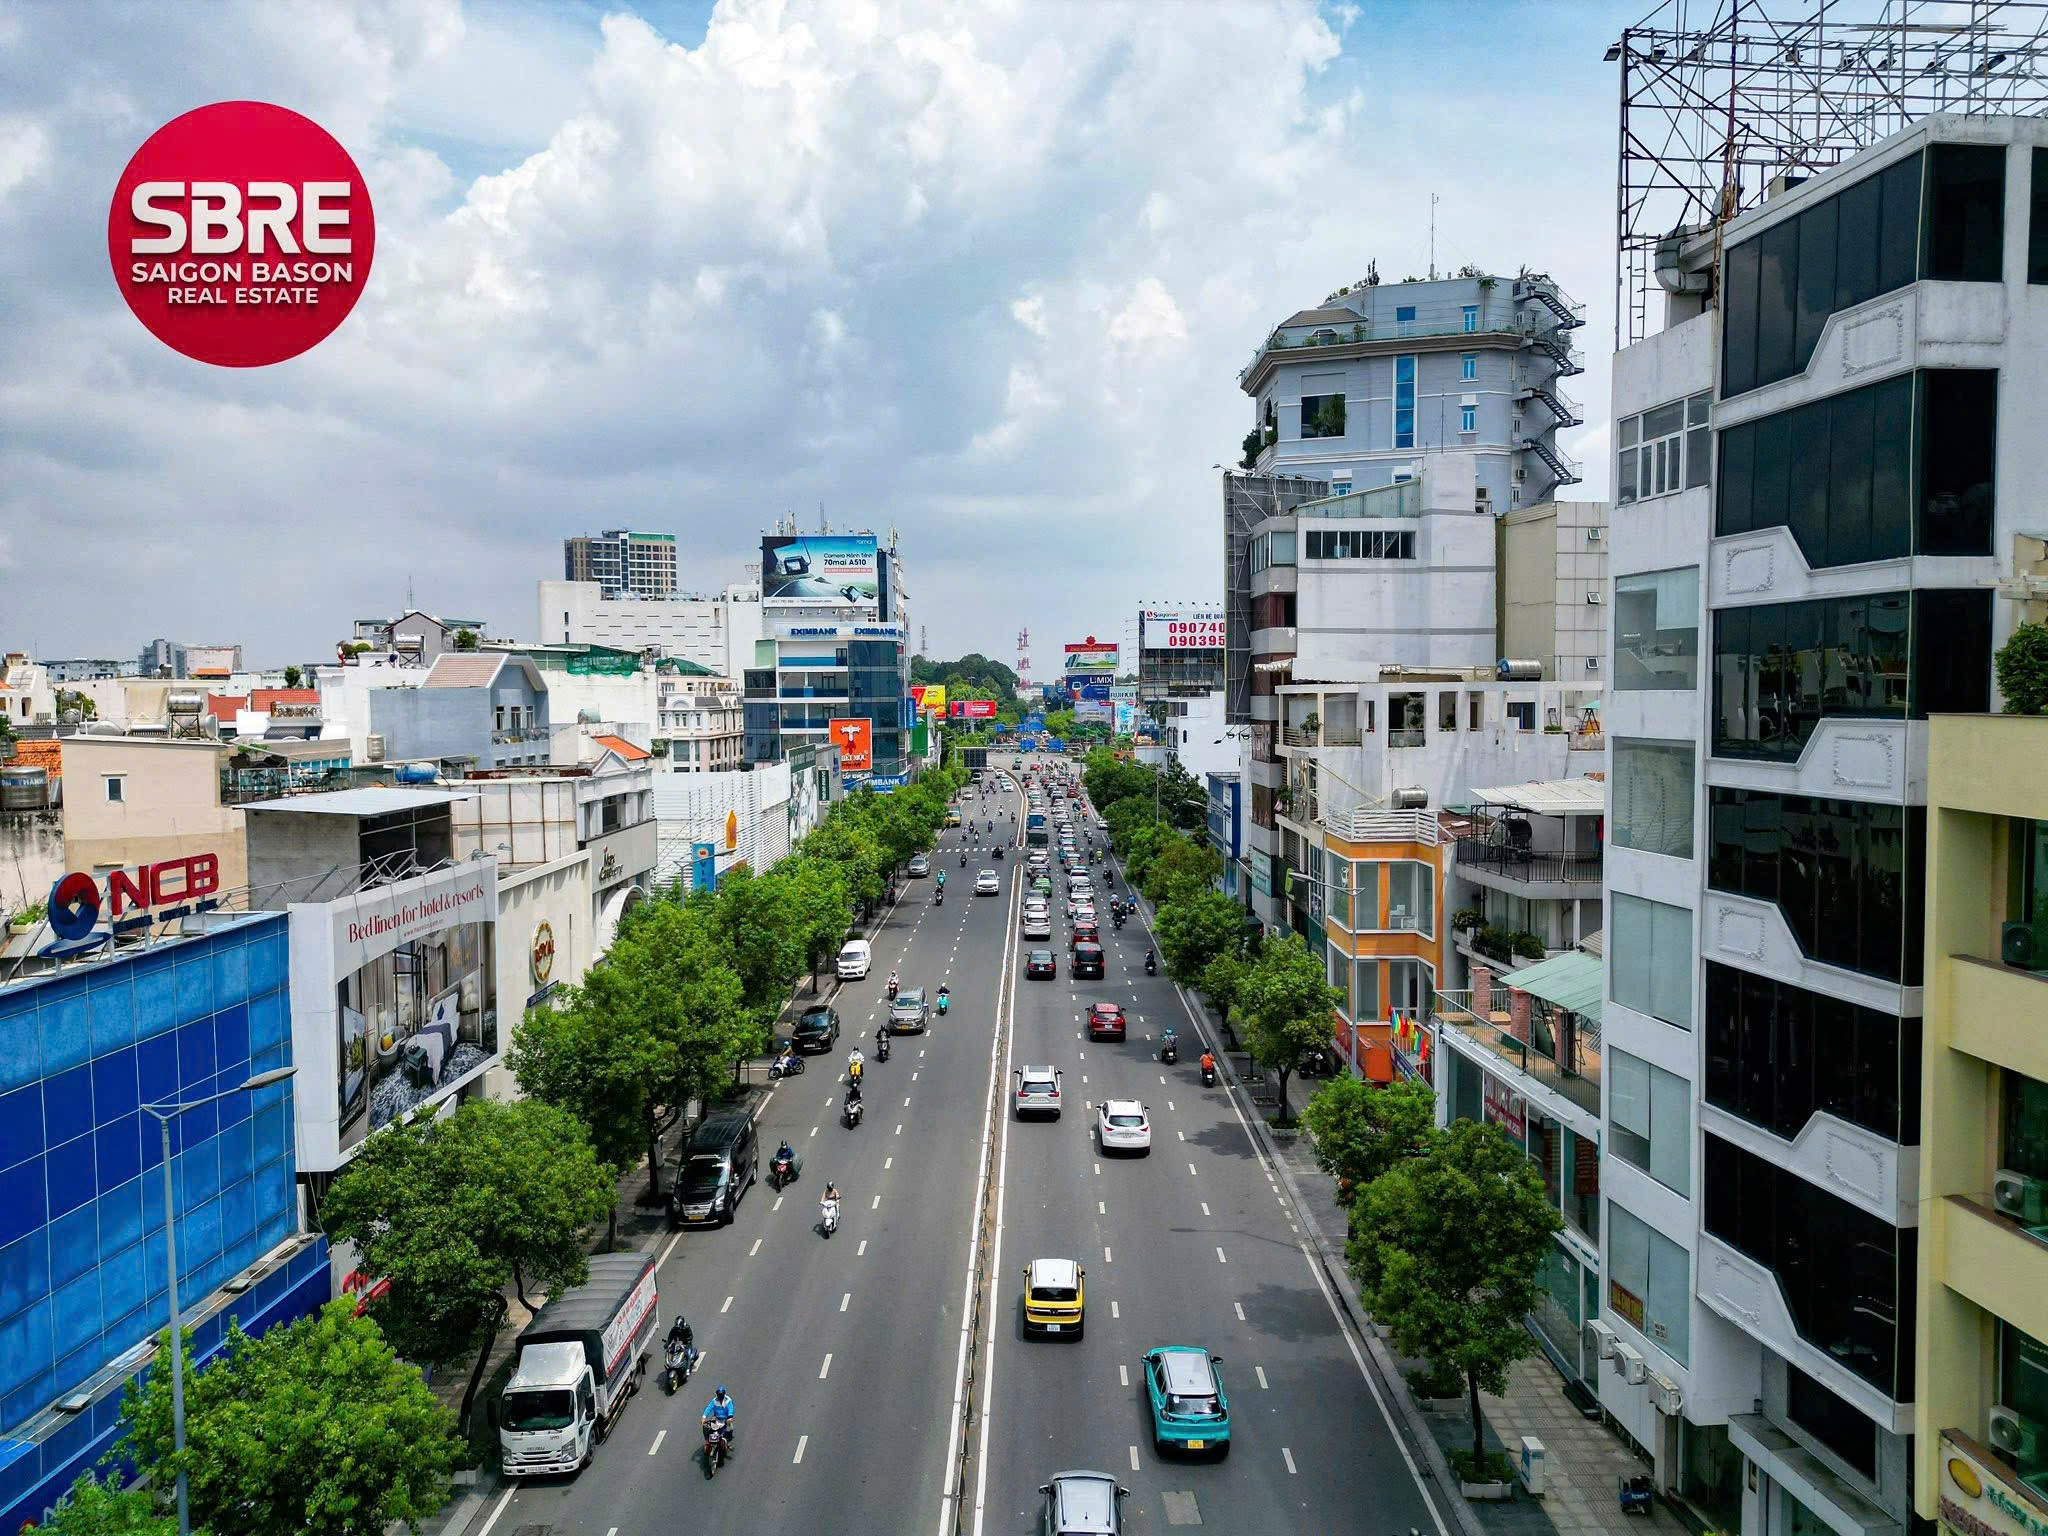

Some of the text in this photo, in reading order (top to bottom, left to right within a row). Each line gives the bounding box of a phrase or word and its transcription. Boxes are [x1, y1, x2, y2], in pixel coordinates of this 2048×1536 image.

[854, 628, 897, 636] EXIMBANK
[110, 852, 219, 916] NCB
[349, 883, 485, 943] Bed linen for hotel & resorts
